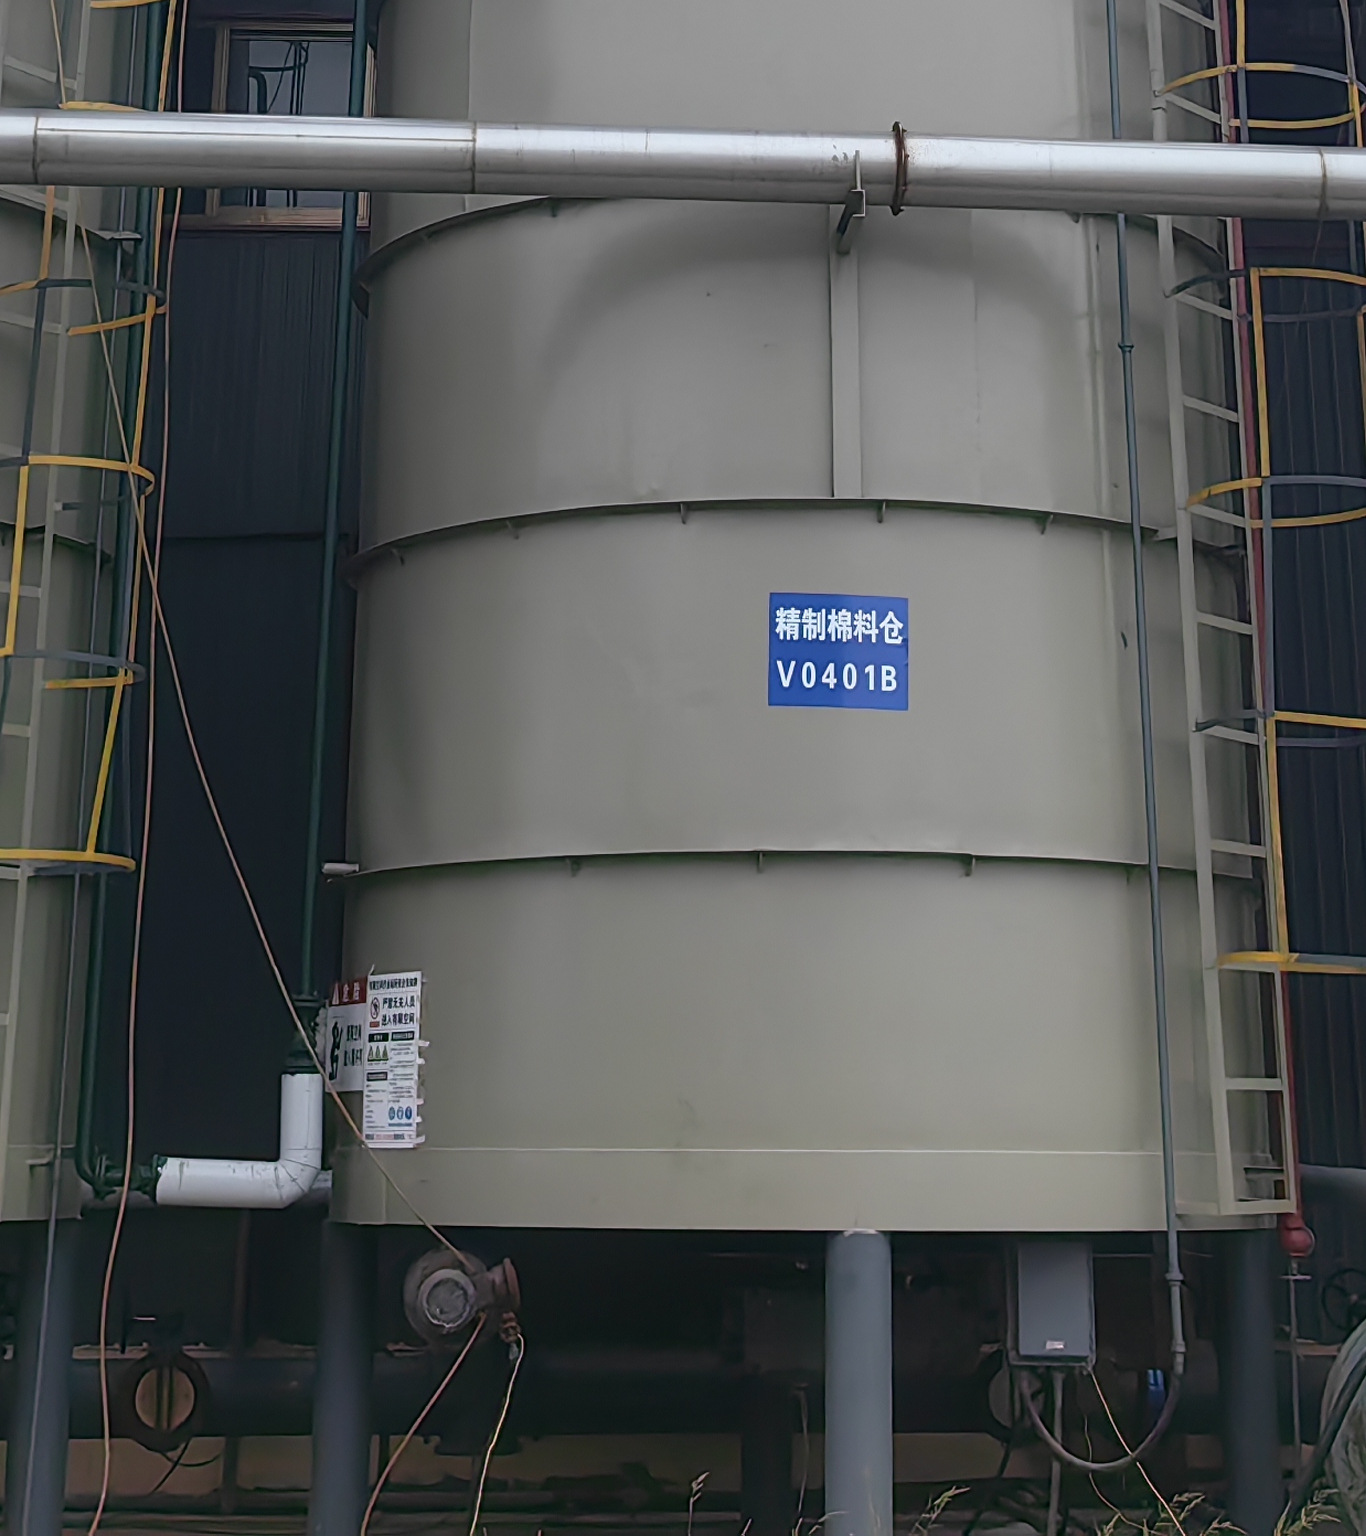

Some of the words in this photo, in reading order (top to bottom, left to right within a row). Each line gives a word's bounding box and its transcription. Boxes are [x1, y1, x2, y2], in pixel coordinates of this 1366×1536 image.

[775, 607, 904, 644] 精制棉料仓
[776, 660, 897, 691] V0401B
